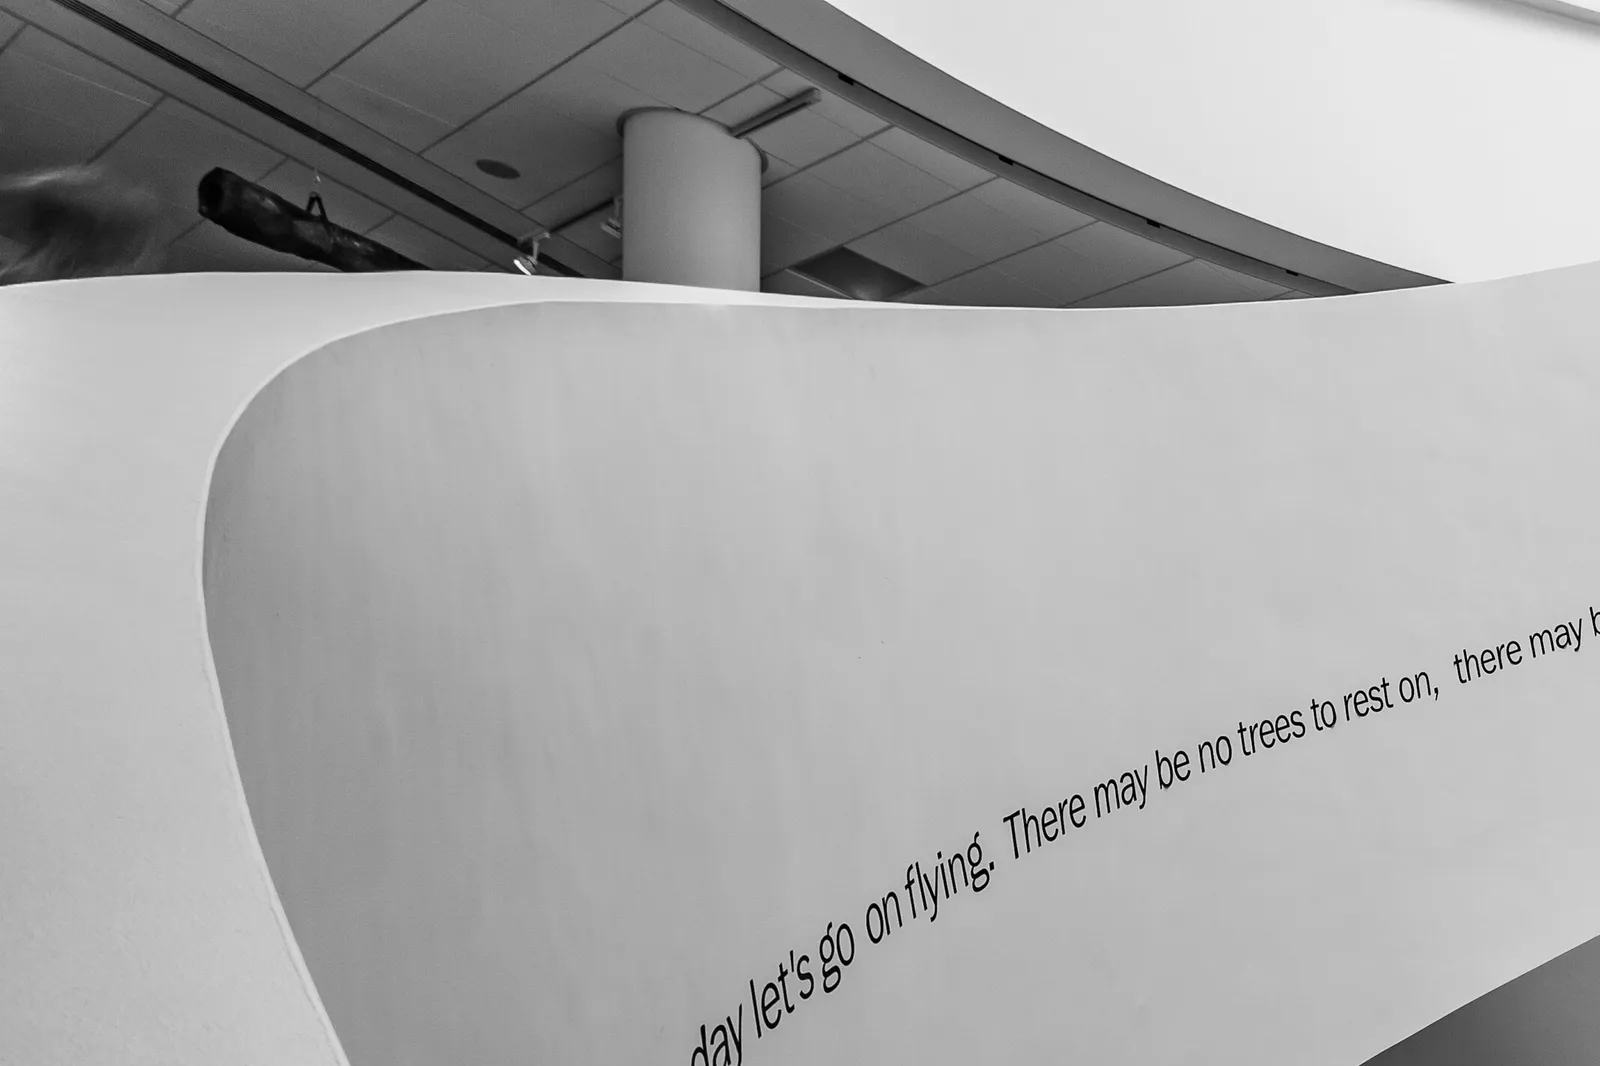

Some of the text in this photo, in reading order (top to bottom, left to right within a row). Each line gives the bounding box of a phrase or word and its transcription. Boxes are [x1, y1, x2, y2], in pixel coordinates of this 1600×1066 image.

[819, 921, 855, 994] go
[865, 891, 903, 945] on
[904, 830, 995, 923] flying.
[1002, 794, 1087, 860] There
[1093, 764, 1148, 819] may
[1154, 749, 1192, 790] be
[1197, 735, 1233, 774] no
[1237, 710, 1306, 757] trees
[1309, 698, 1337, 732] to
[1343, 677, 1394, 722] rest
[1398, 671, 1439, 703] on,
[1453, 640, 1523, 684] there
[1528, 618, 1583, 659] may
